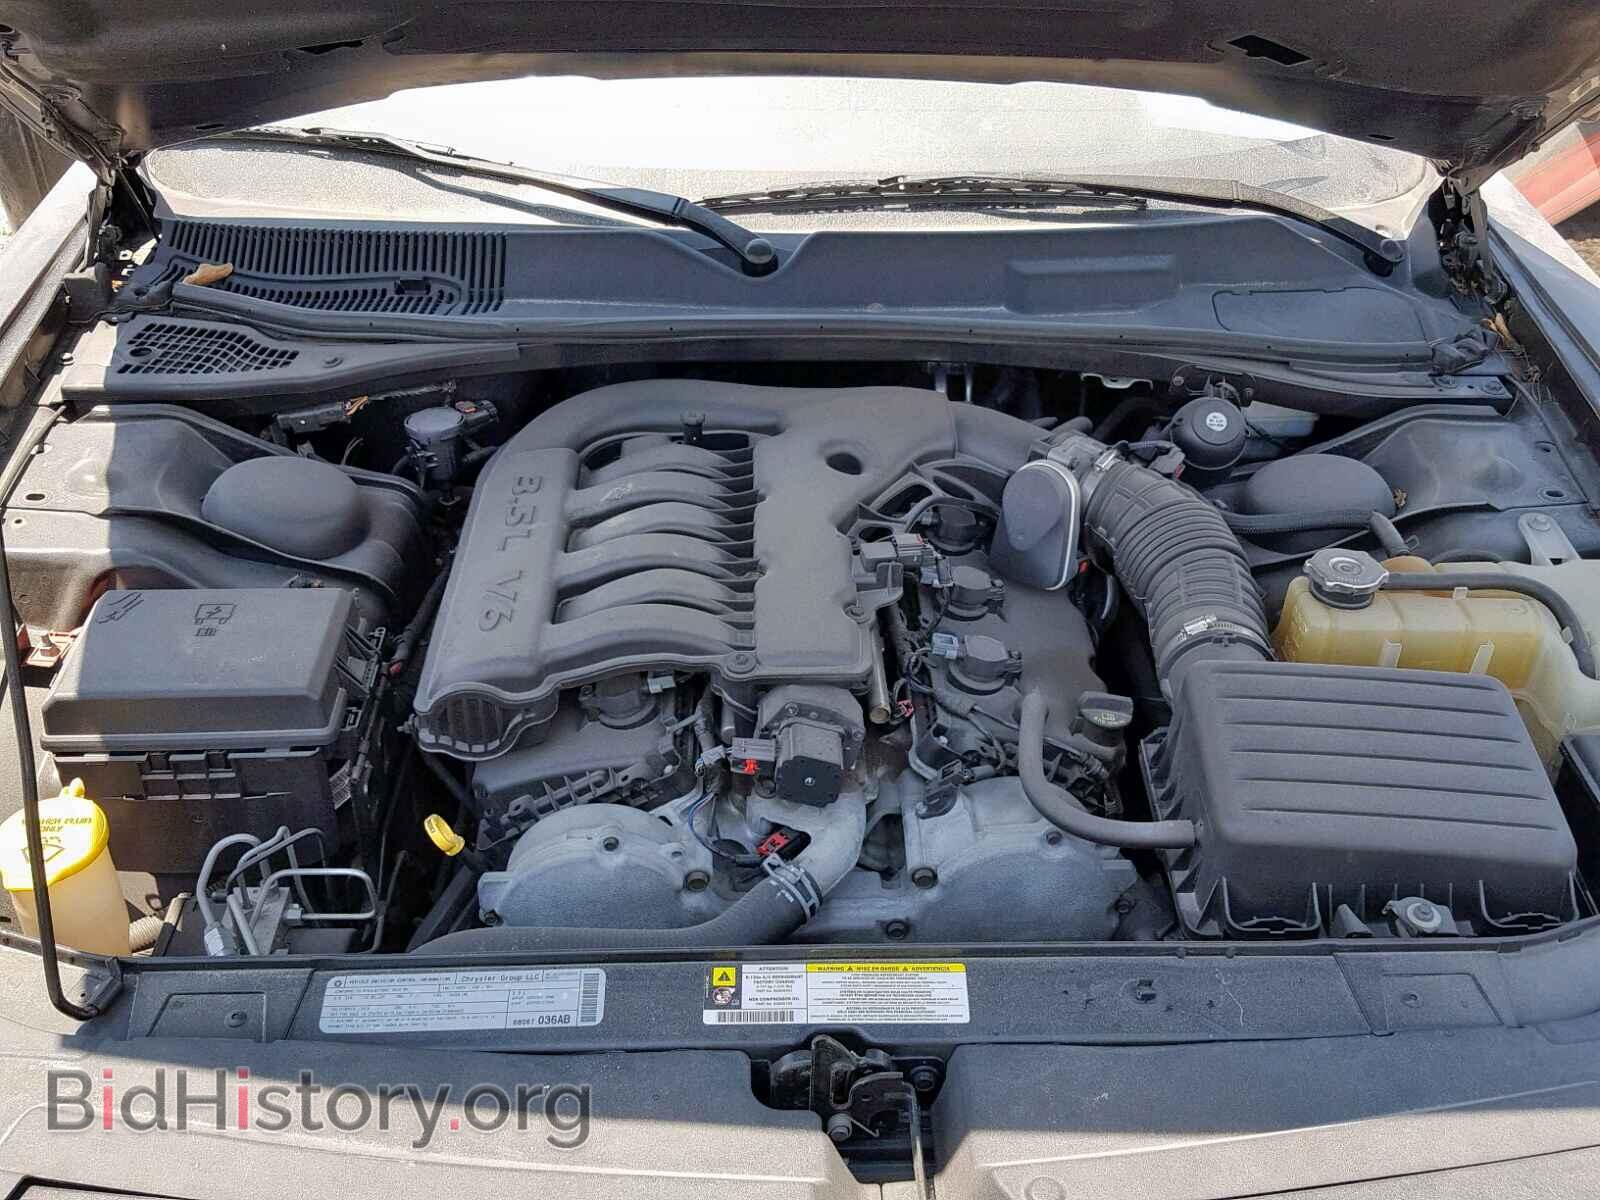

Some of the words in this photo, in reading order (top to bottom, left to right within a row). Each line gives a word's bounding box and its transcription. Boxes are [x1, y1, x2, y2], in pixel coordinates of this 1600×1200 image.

[499, 475, 543, 552] 3.5L
[478, 570, 526, 632] V6
[461, 975, 495, 983] Chrysler
[500, 974, 521, 982] Group
[538, 1014, 570, 1025] 036AB
